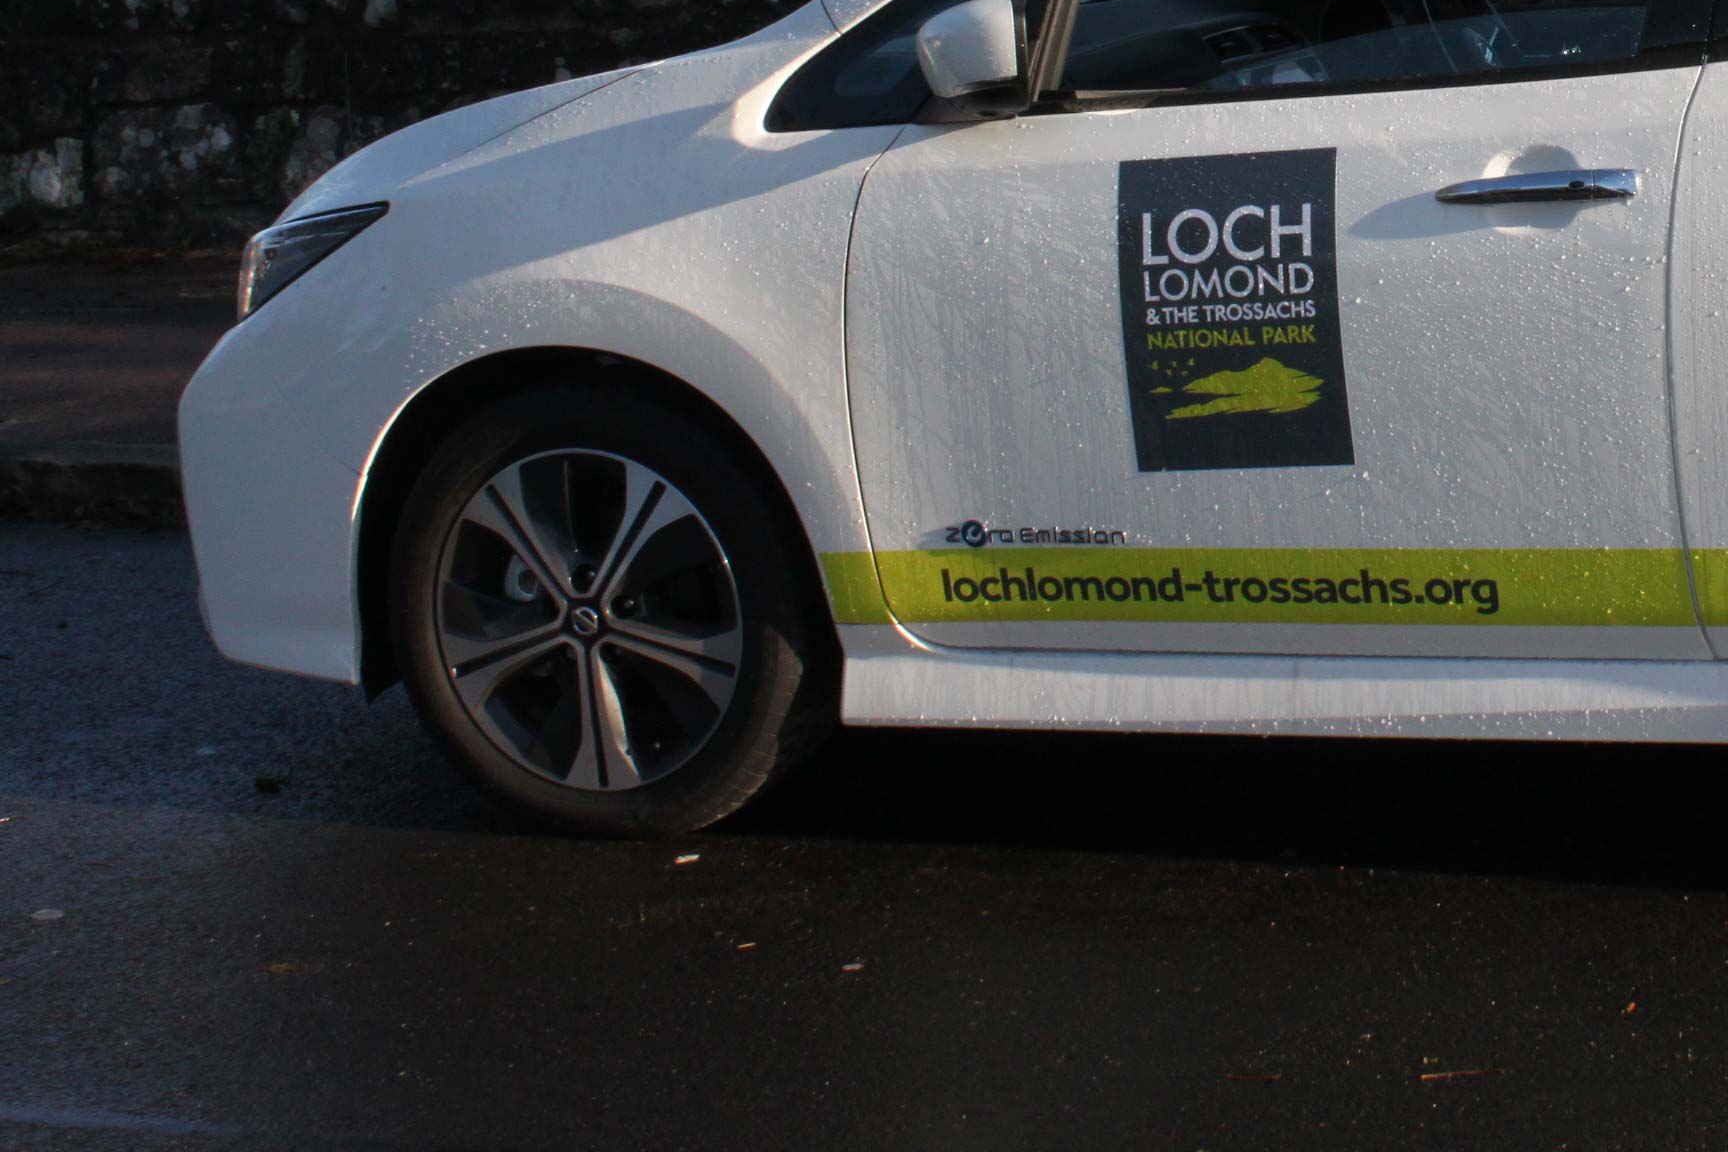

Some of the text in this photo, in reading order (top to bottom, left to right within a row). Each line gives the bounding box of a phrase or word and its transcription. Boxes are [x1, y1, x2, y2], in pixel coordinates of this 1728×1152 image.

[1142, 203, 1312, 265] LOCH
[1143, 262, 1314, 301] LOMOND
[1146, 299, 1316, 325] & THE TROSSACHS
[1147, 324, 1316, 350] NATIONAL PARK
[1020, 526, 1127, 545] Emission
[941, 567, 1499, 614] lochlomond-trossachs.org
